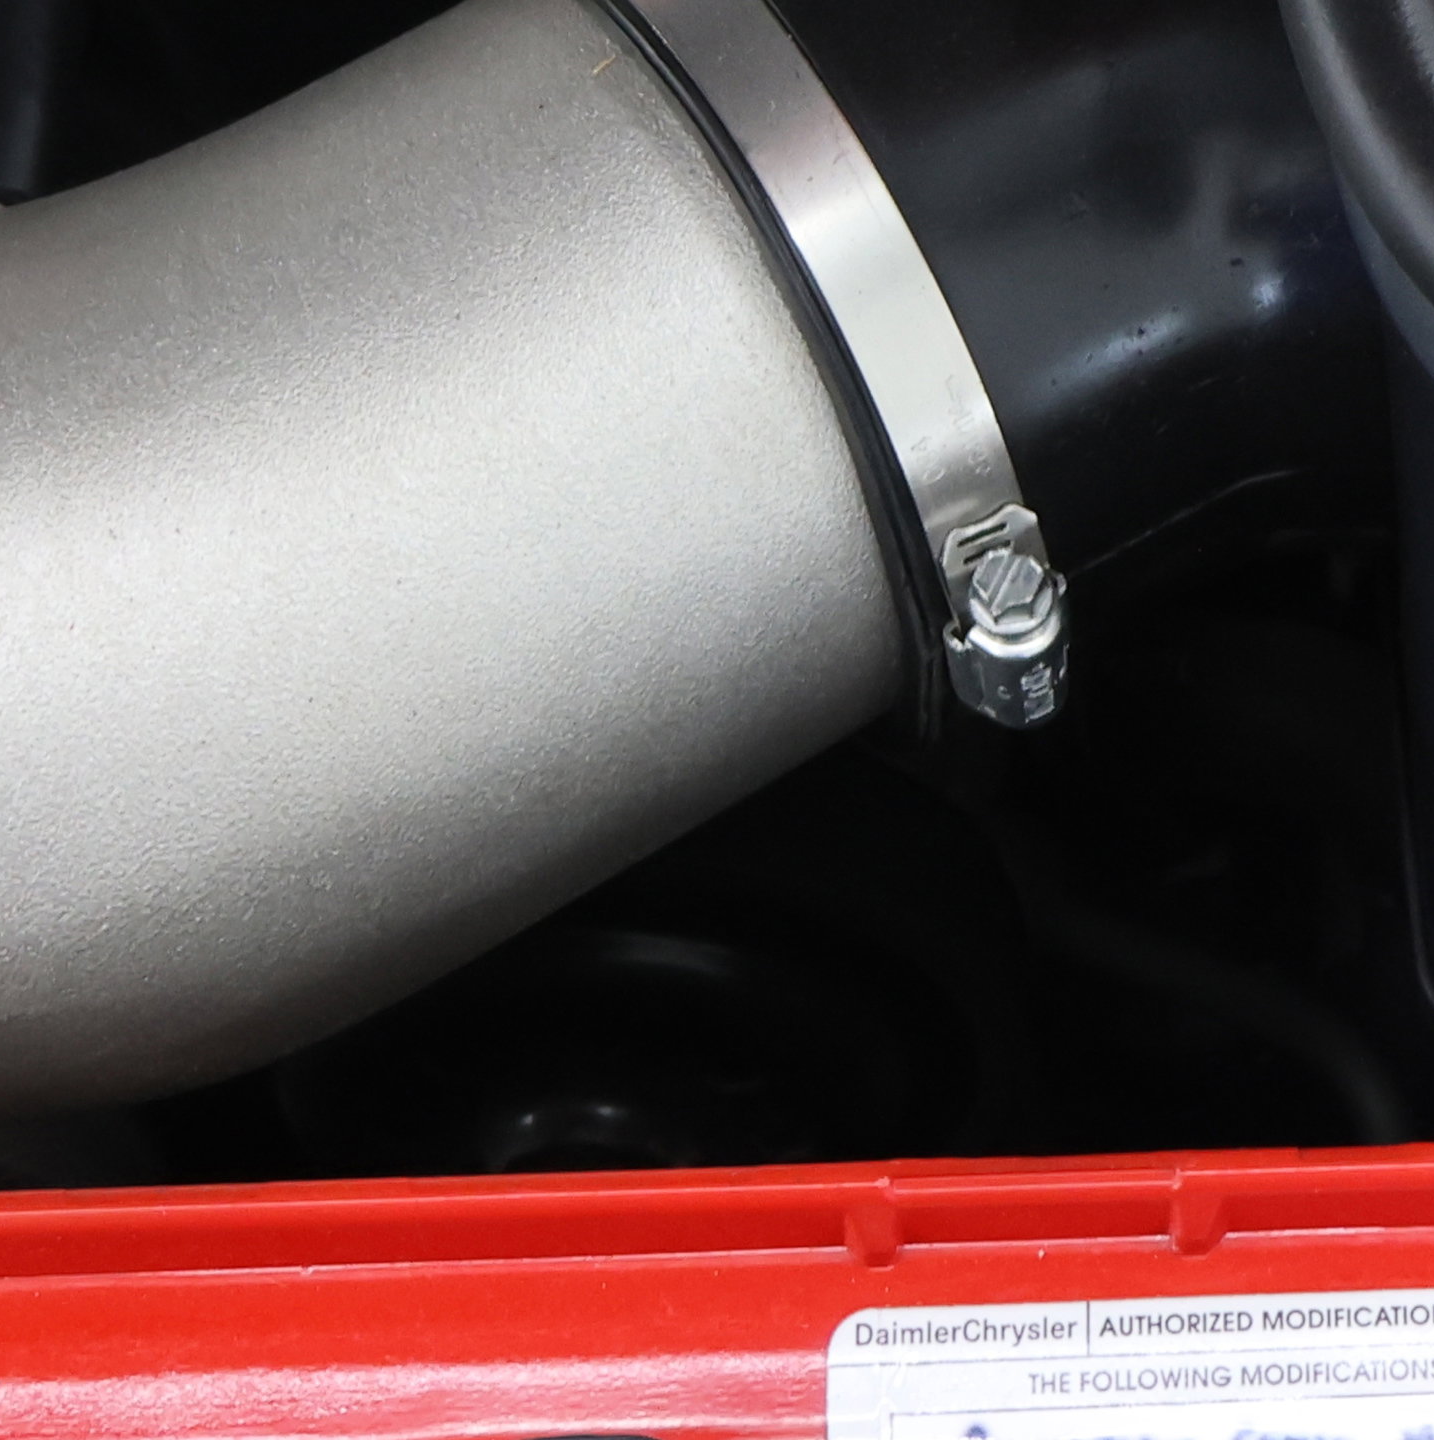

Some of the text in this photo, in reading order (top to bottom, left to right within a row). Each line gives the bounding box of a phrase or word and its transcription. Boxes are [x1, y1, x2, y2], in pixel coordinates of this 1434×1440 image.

[855, 1316, 1077, 1347] DaimlerChrysler
[1098, 1310, 1253, 1337] AUTHORIZED
[1028, 1372, 1070, 1395] THE
[1079, 1365, 1232, 1393] FOLLOWING
